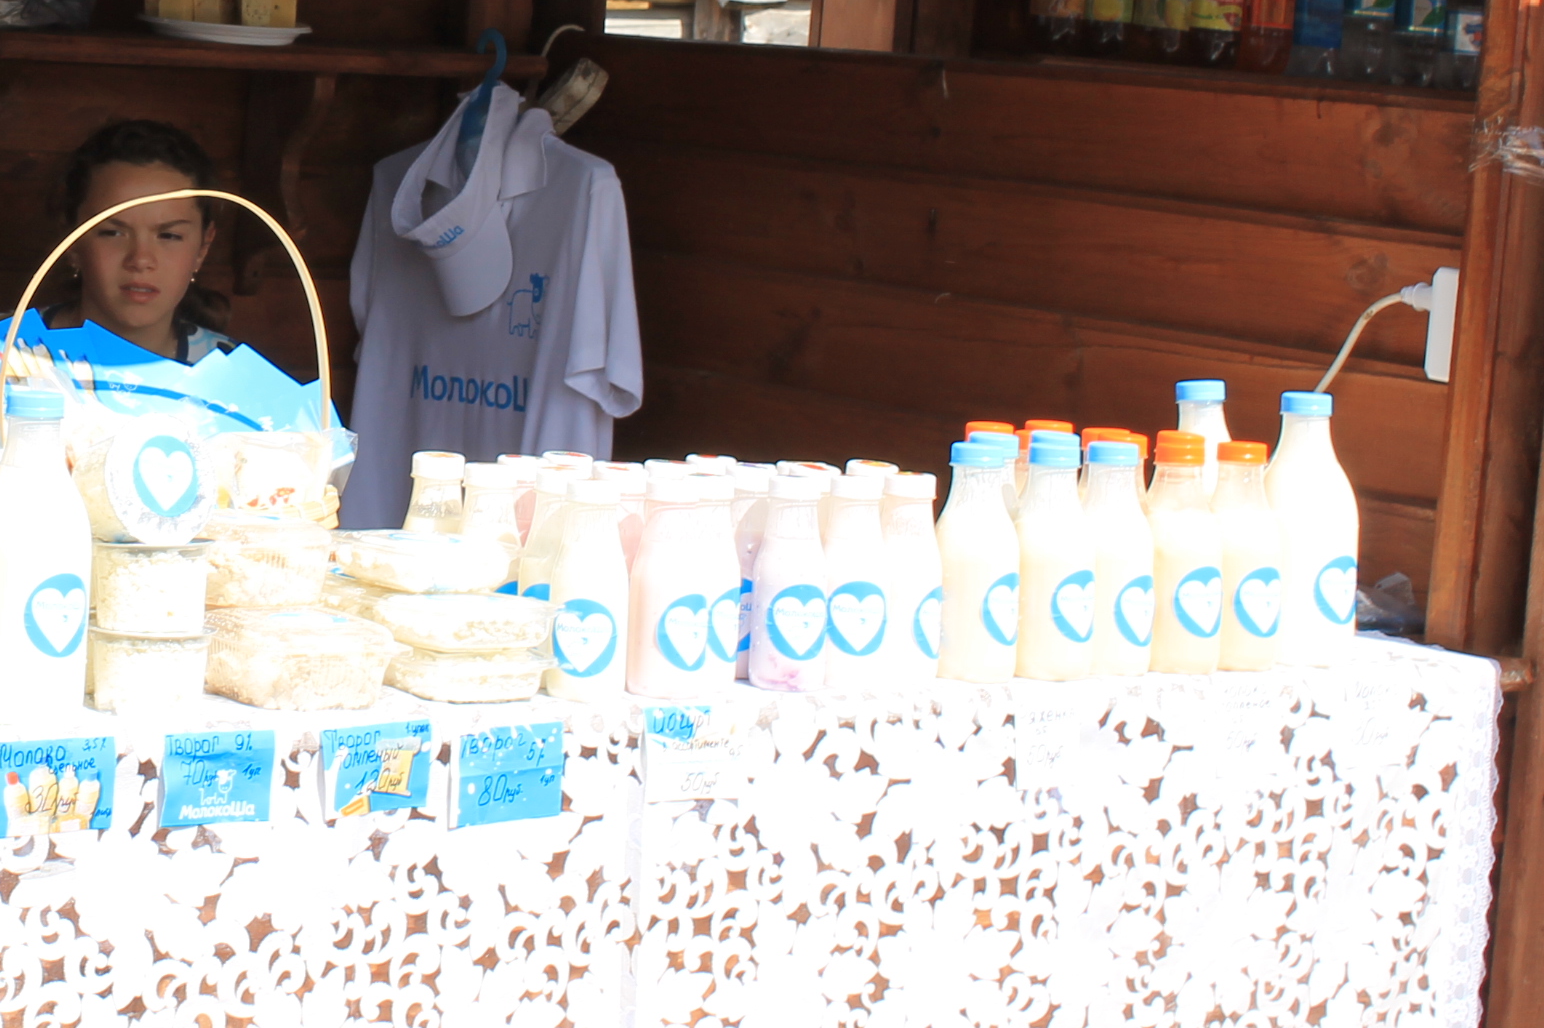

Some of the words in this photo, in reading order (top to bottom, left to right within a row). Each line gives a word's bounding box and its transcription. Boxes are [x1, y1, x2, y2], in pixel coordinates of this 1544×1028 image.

[410, 365, 529, 413] МолокоШ
[165, 734, 219, 760] Творог
[178, 800, 257, 821] МолокоШа
